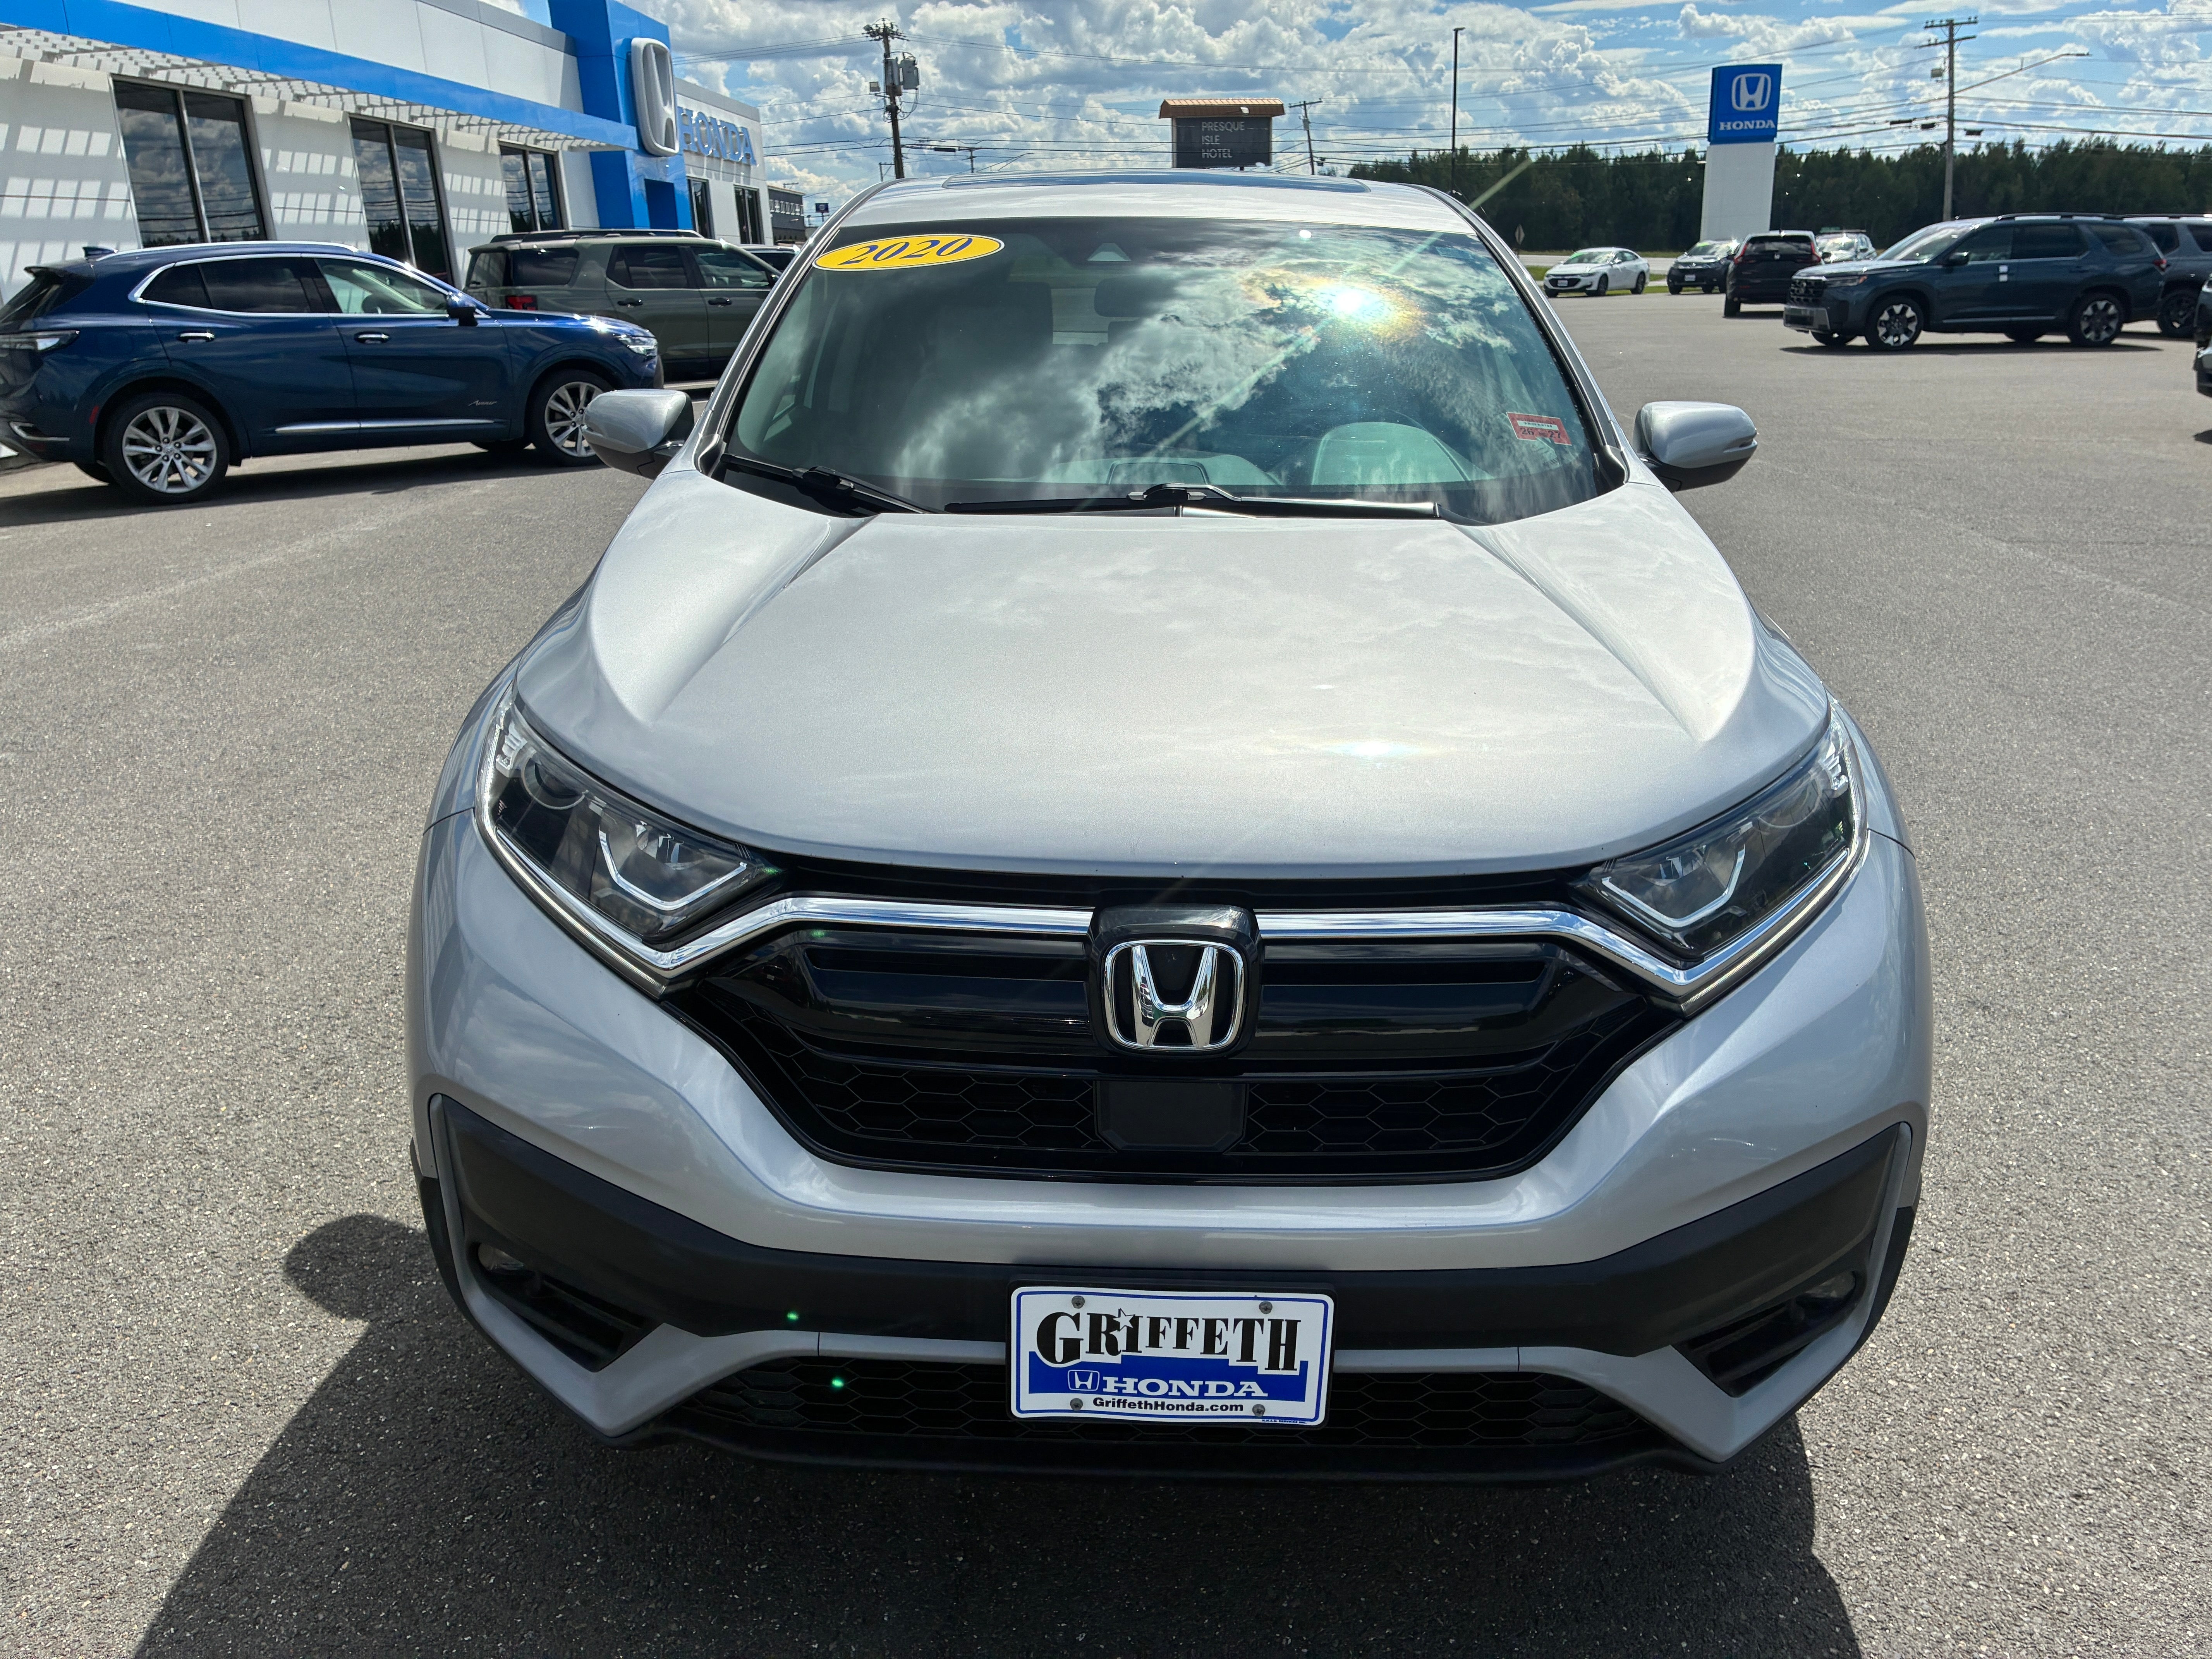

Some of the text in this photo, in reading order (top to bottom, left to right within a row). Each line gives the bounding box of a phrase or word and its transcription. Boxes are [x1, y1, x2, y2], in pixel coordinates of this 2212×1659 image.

[1201, 122, 1245, 132] PRESQUE
[1719, 119, 1775, 131] HONDA
[677, 106, 757, 166] HONDA
[1202, 135, 1220, 144] ISLE
[1202, 149, 1233, 158] HOTEL
[837, 237, 972, 266] 2020
[1036, 1311, 1301, 1371] GRIFFETH
[1102, 1376, 1268, 1397] HONDA
[1093, 1397, 1244, 1412] GriffethHonda.com
